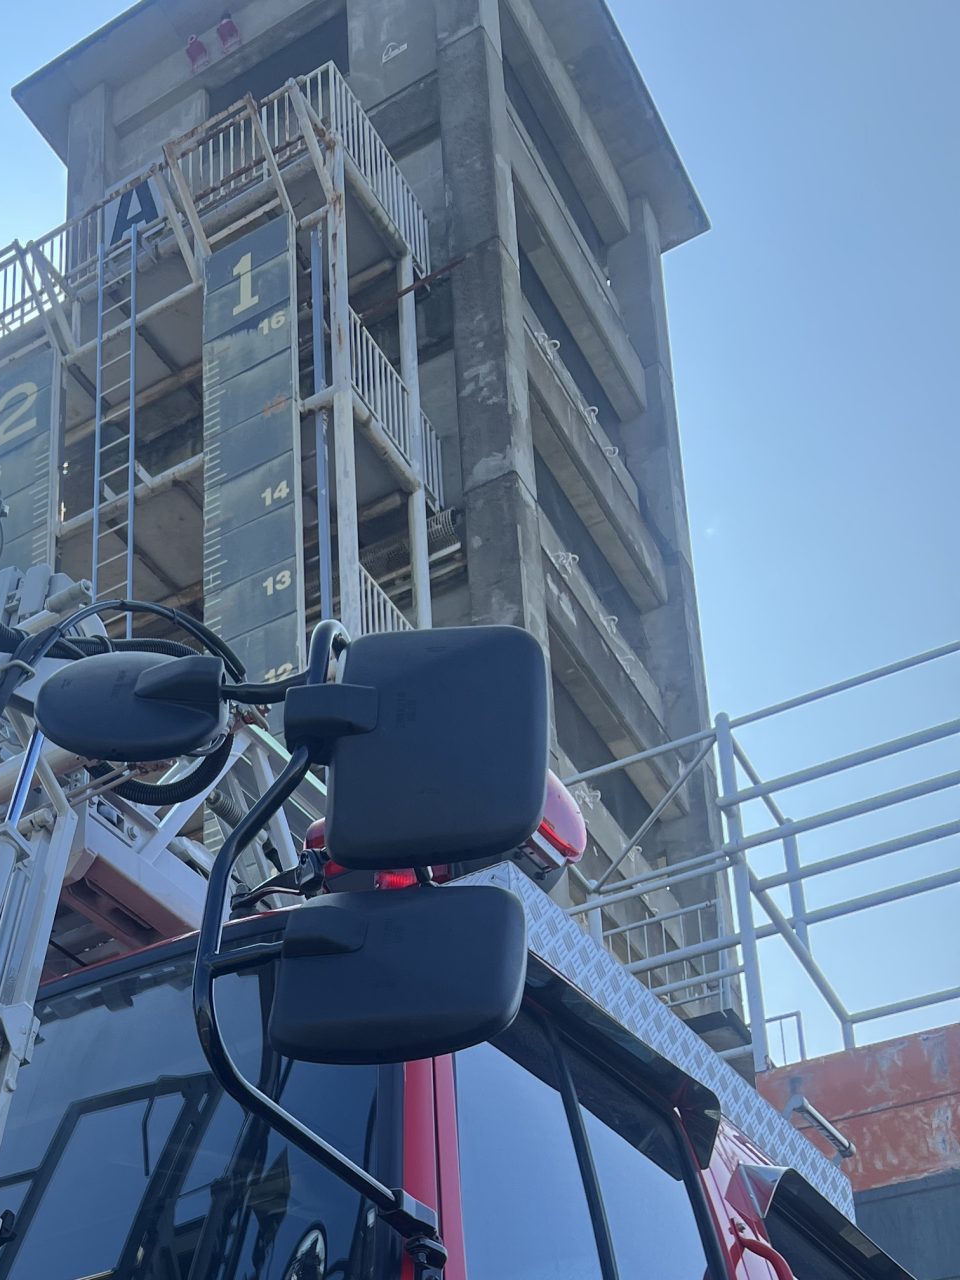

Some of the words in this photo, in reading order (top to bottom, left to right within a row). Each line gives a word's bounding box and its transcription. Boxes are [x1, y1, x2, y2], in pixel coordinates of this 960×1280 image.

[110, 179, 159, 246] A
[233, 252, 259, 316] 1
[258, 310, 286, 336] 16
[261, 479, 290, 506] 14
[262, 570, 291, 595] 13
